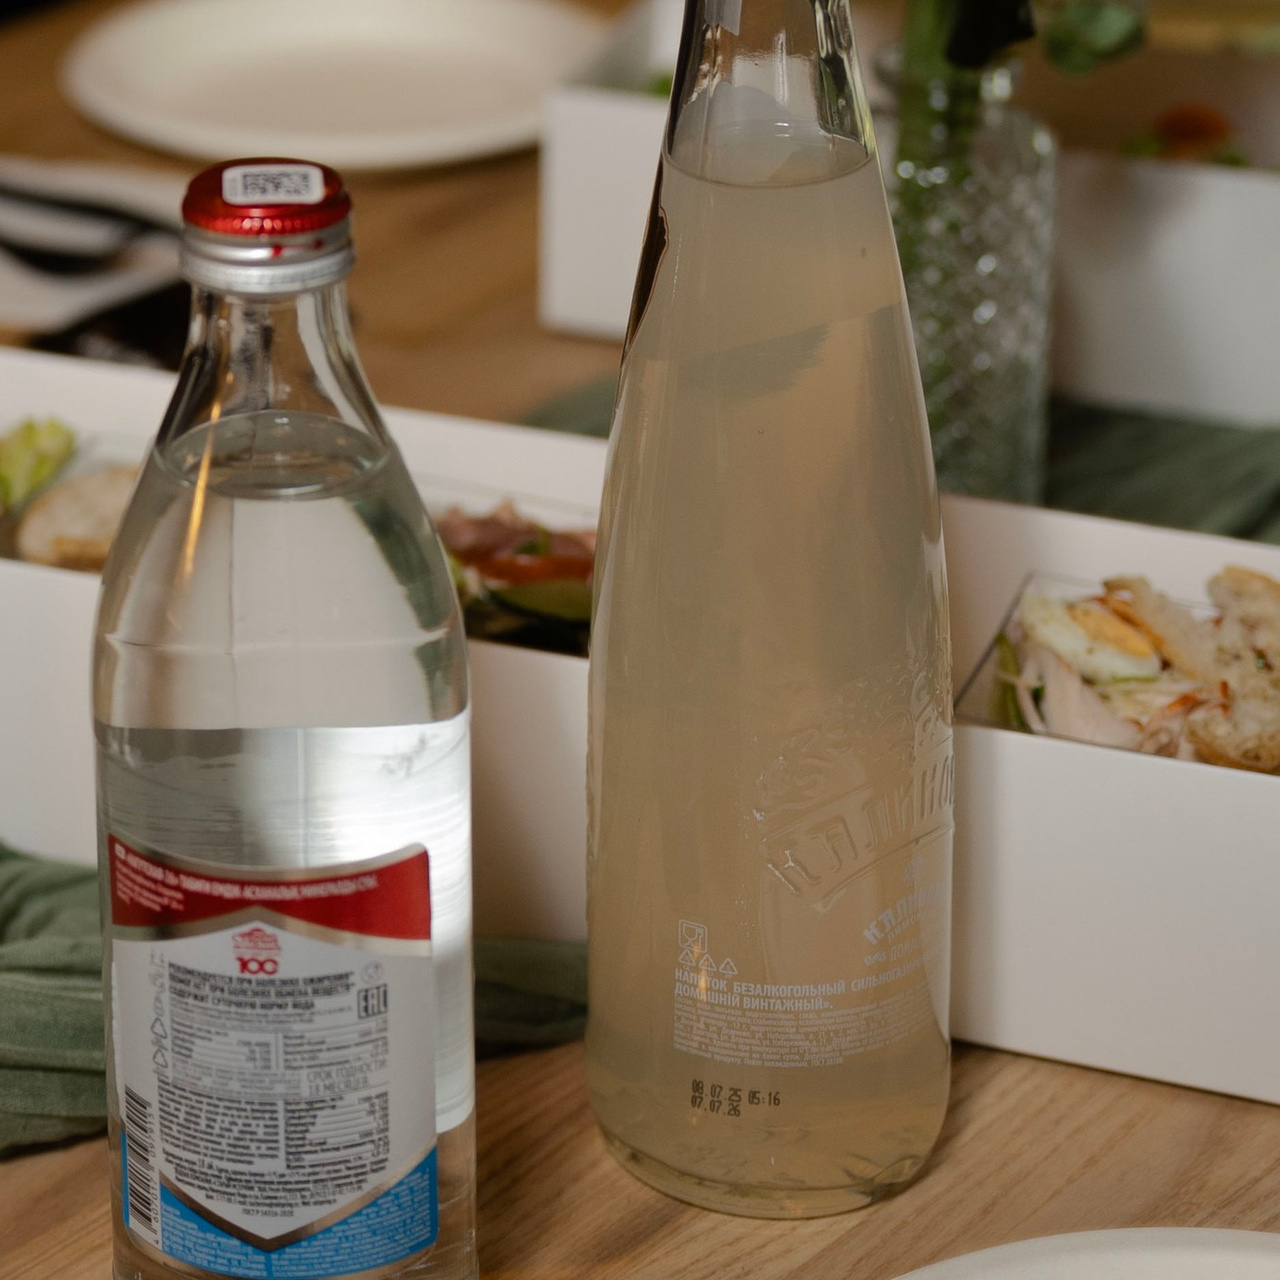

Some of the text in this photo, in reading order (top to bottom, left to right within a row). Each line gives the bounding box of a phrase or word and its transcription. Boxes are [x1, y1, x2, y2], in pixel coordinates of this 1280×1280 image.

[236, 957, 279, 975] 100
[733, 979, 846, 998] БЕЗАЛКОГОЛЬНЫЙ
[691, 1078, 782, 1108] 08.07.25 05:16
[690, 1095, 742, 1118] 07.07.26
